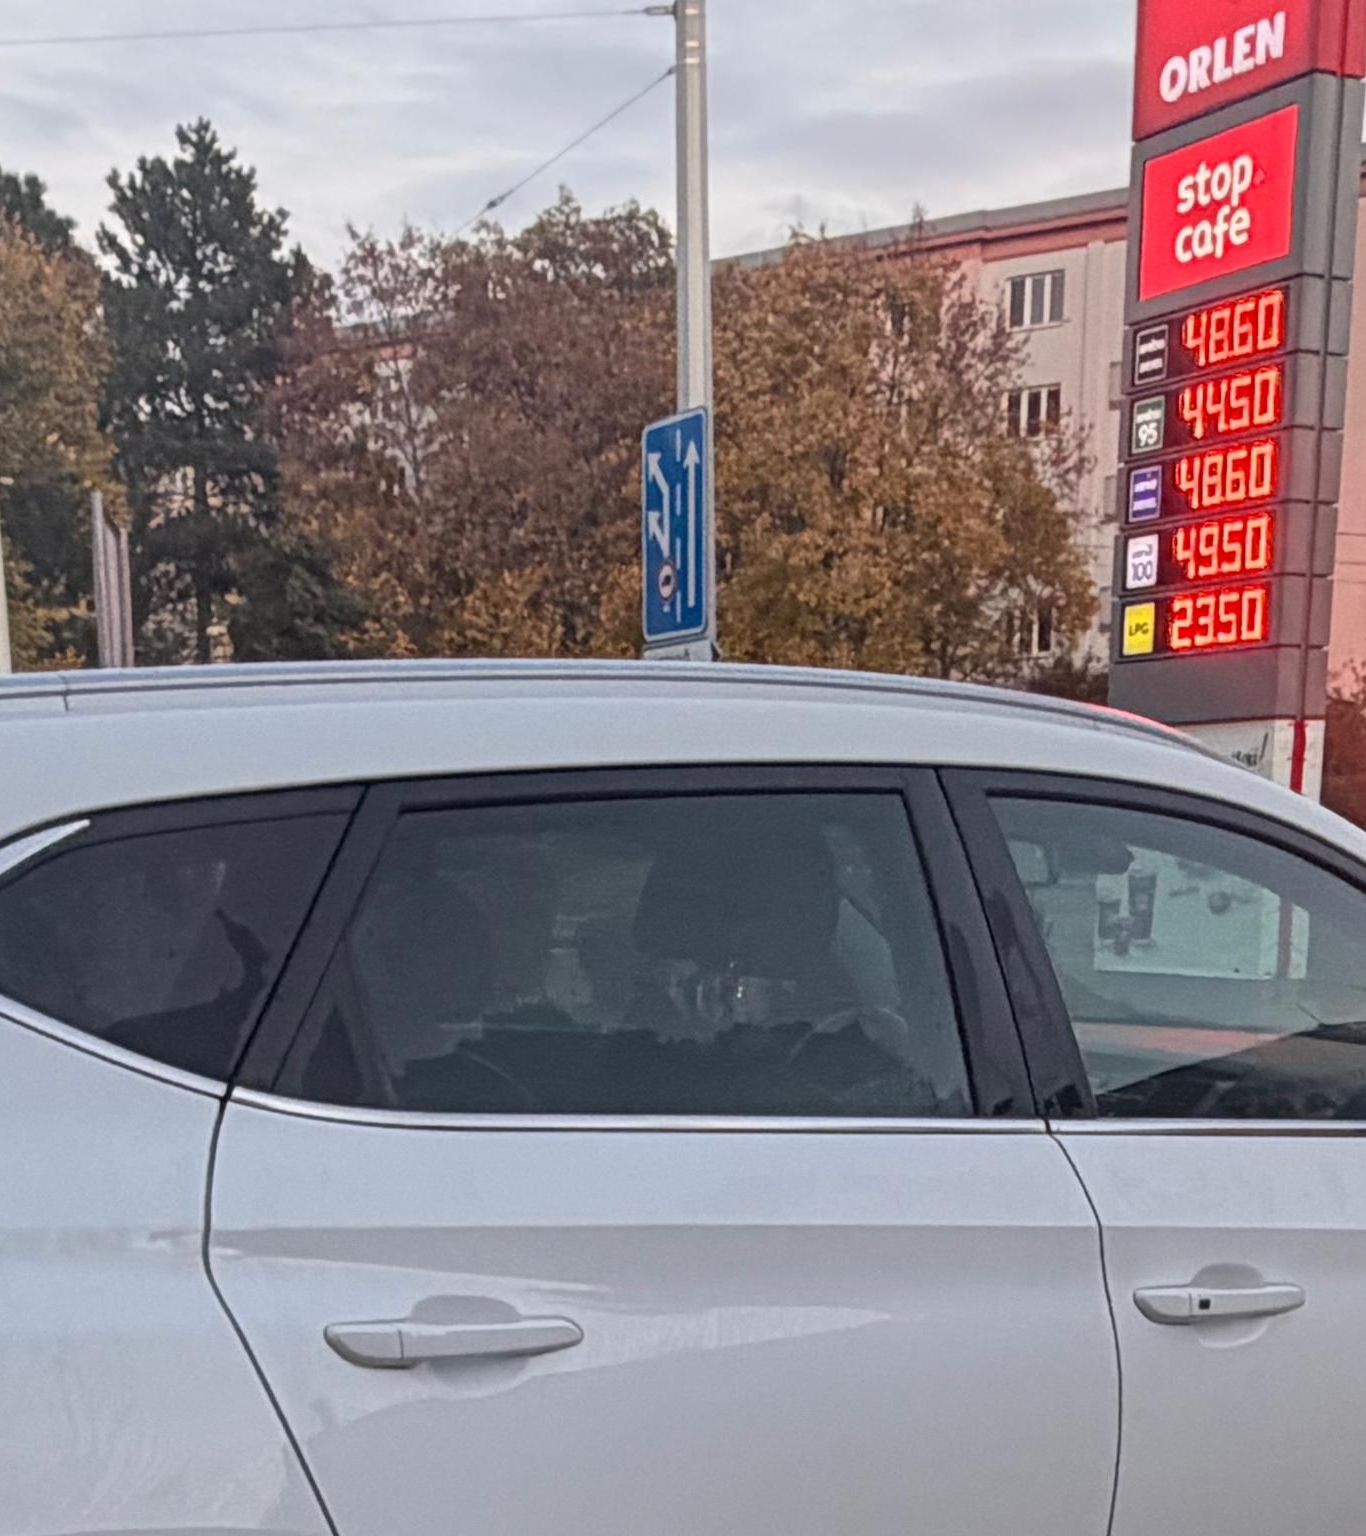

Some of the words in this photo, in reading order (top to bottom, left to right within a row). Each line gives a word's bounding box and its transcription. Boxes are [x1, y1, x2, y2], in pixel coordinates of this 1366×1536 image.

[1159, 11, 1286, 102] ORLEN
[1177, 154, 1253, 214] stop
[1175, 205, 1251, 263] cafe
[1138, 422, 1158, 447] 95
[1131, 560, 1153, 581] 100
[1129, 621, 1150, 637] LPG
